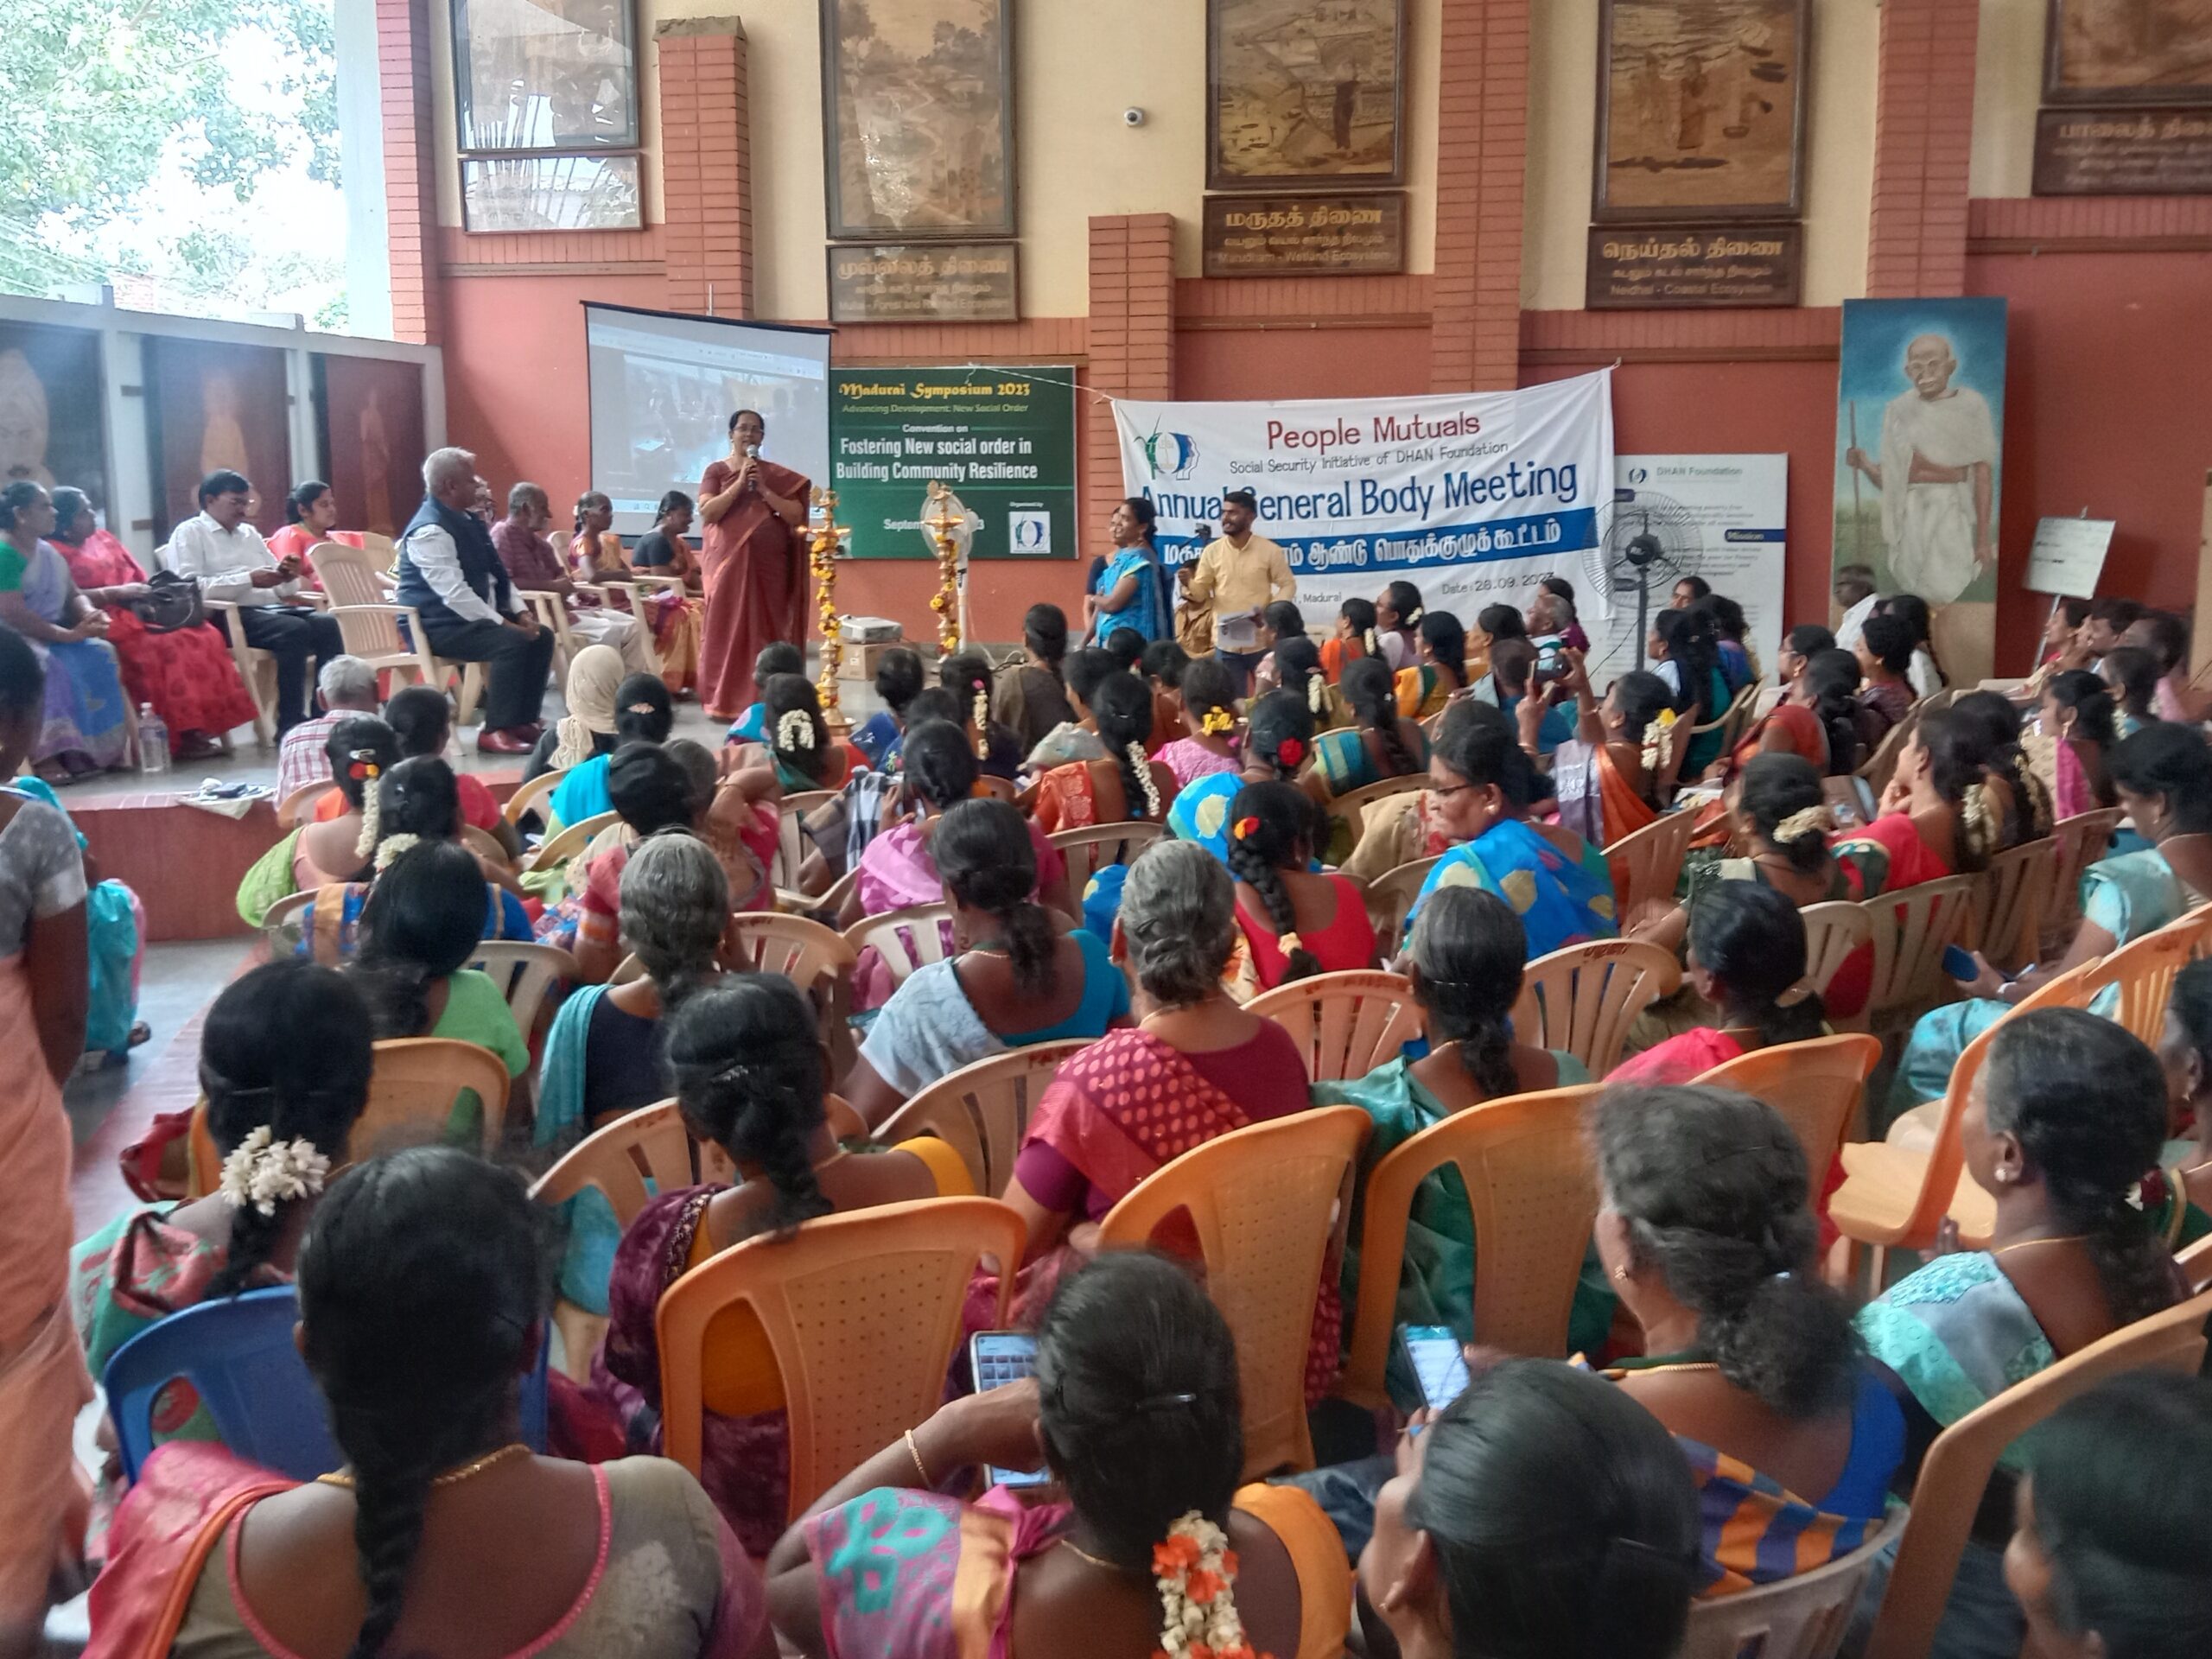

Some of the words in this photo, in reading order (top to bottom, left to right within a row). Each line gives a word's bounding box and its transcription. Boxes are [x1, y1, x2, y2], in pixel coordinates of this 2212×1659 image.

[1225, 205, 1305, 230] மருதத்
[1308, 205, 1382, 228] திணை
[1603, 237, 1702, 262] நெய்தல்
[1706, 236, 1783, 260] திணை
[940, 256, 1007, 276] திணை
[838, 383, 906, 399] Madurai
[910, 383, 992, 398] Symposium
[998, 384, 1030, 397] 2023
[842, 404, 889, 415] Advancing
[1001, 404, 1028, 412] Order
[902, 423, 955, 433] Convention
[1267, 417, 1361, 455] People
[1373, 411, 1480, 442] Mutuals
[840, 438, 902, 458] Fostering
[905, 438, 933, 454] New
[937, 438, 976, 454] social
[980, 438, 1015, 454] order
[1019, 438, 1033, 454] in
[1230, 459, 1263, 474] Social
[1268, 458, 1317, 474] Security
[1322, 454, 1370, 470] Initiative
[1376, 452, 1389, 465] of
[1396, 448, 1433, 464] DHAN
[1440, 441, 1509, 460] Foundation
[836, 462, 889, 482] Building
[892, 462, 966, 482] Community
[969, 462, 1038, 479] Resilience
[1244, 480, 1351, 520] eneral
[1360, 475, 1434, 521] Body
[1444, 461, 1577, 508] Meeting
[1308, 539, 1368, 570] ஆண்டு
